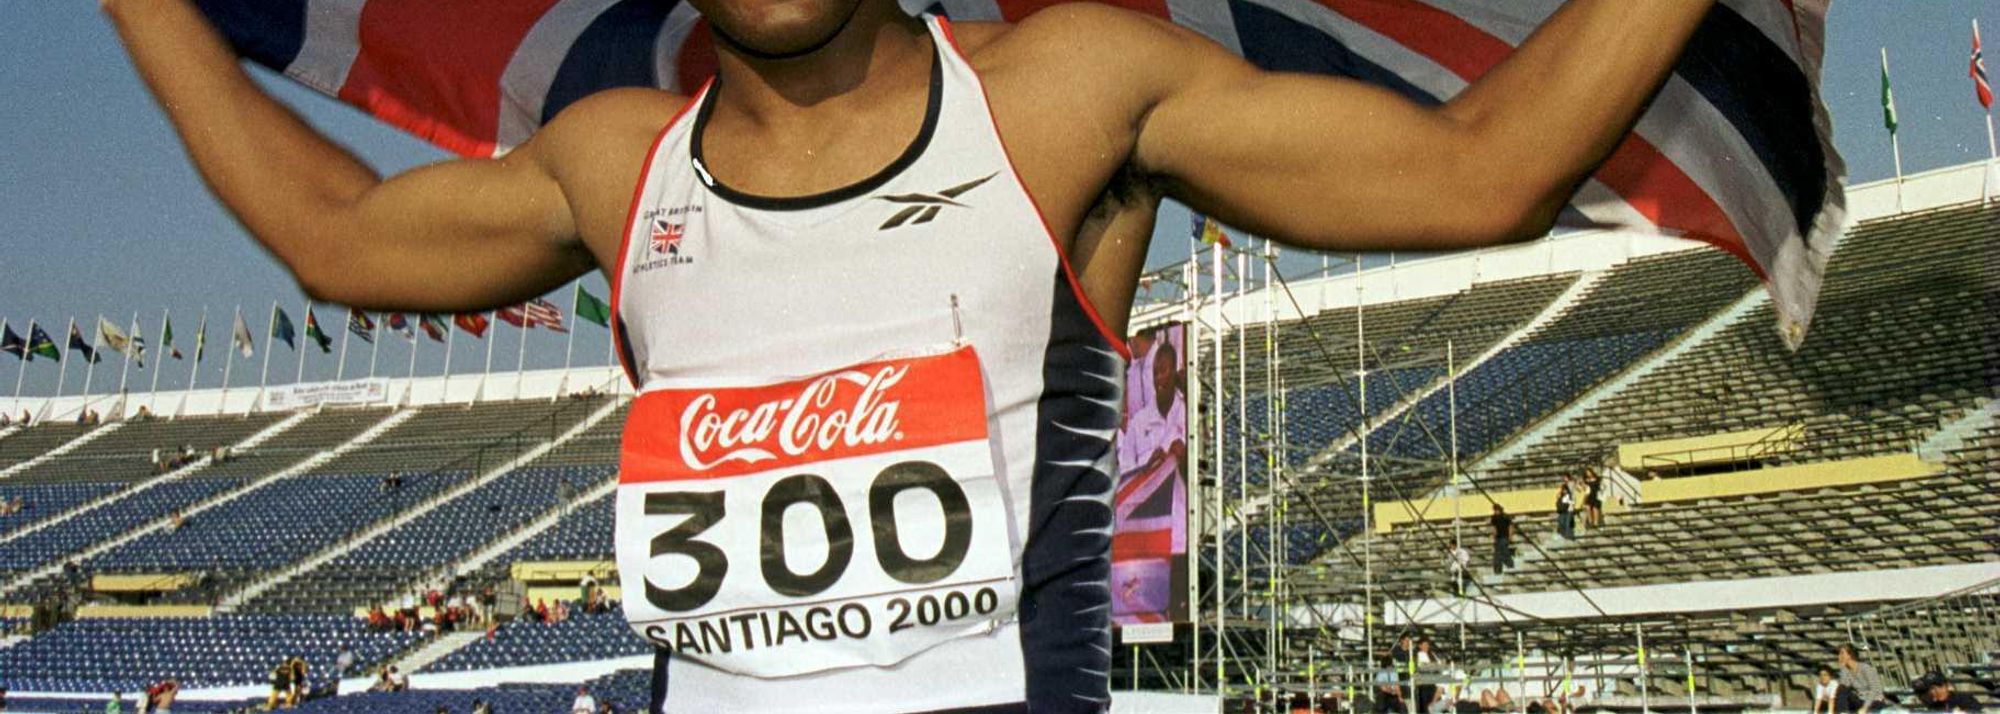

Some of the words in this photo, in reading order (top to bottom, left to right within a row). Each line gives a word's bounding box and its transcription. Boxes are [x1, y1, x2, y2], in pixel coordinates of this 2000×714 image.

[670, 256, 693, 264] TEAM
[680, 365, 909, 471] Coca-Cola
[644, 460, 973, 612] 300
[645, 602, 872, 654] SANTIAGO
[887, 587, 998, 633] 2000
